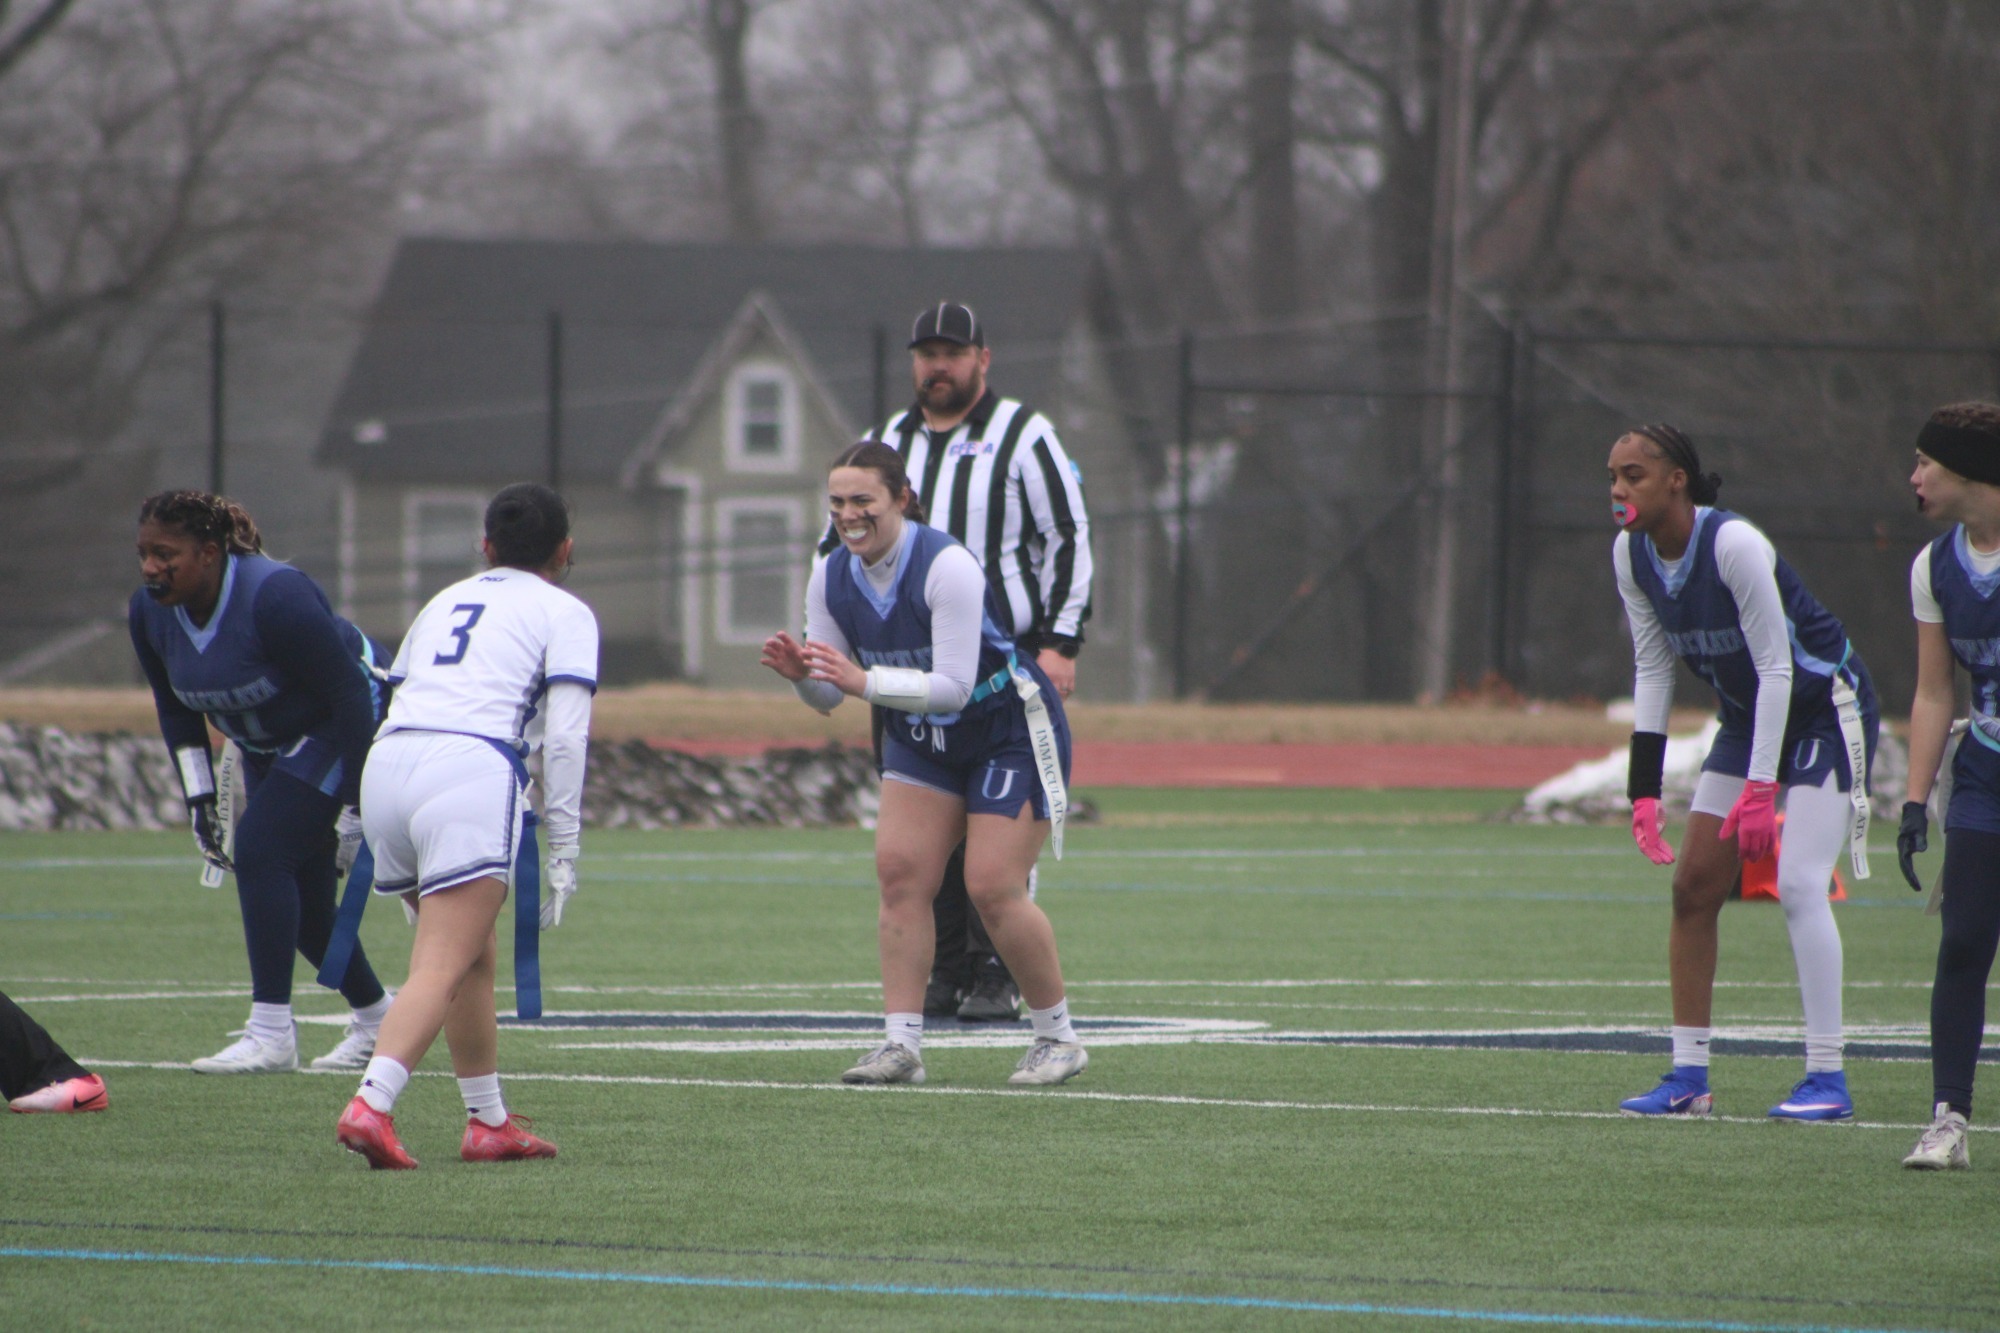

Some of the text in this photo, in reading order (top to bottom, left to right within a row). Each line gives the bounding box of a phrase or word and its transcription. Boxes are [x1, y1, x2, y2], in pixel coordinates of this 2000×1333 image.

[433, 604, 486, 665] 3
[1036, 729, 1064, 825] IMMACULATA
[1851, 741, 1867, 841] IMMACULATA
